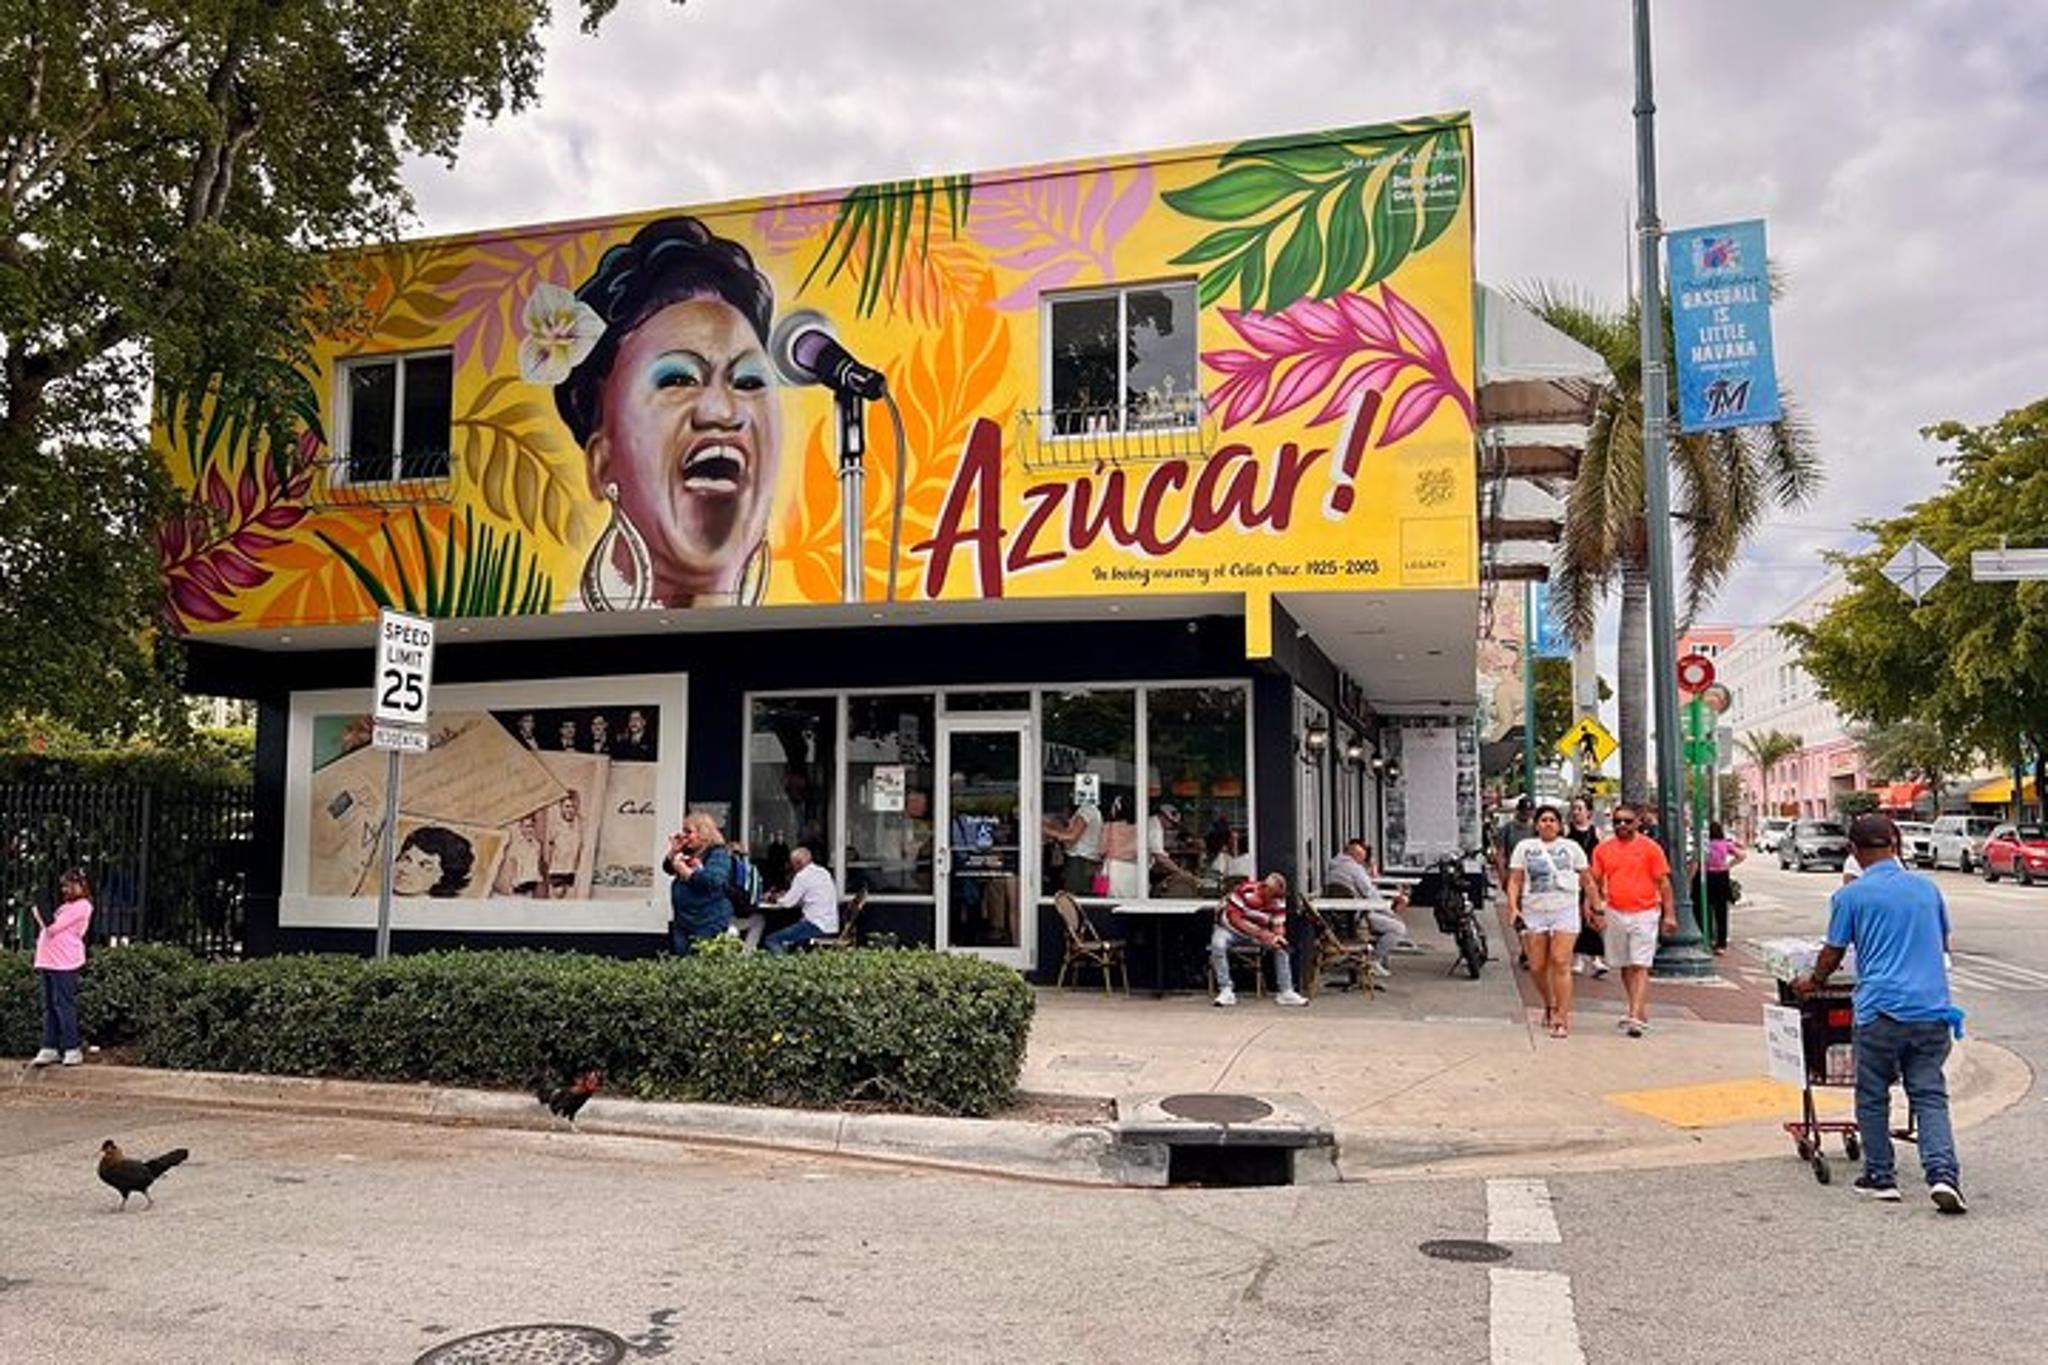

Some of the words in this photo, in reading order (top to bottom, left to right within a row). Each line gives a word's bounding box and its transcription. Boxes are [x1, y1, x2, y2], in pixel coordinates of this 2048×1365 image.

[1682, 287, 1758, 310] BASEBALL
[1713, 307, 1730, 323] IS
[1699, 323, 1747, 344] LITTLE
[1691, 340, 1758, 363] HAVANA
[1092, 565, 1107, 581] In
[1111, 565, 1150, 587] loving
[1152, 567, 1210, 586] memory
[1214, 563, 1227, 578] of
[1229, 561, 1264, 578] Celia
[1266, 561, 1300, 577] Cruz
[384, 622, 430, 647] SPEED
[386, 647, 424, 667] LIMIT
[381, 668, 423, 712] 25
